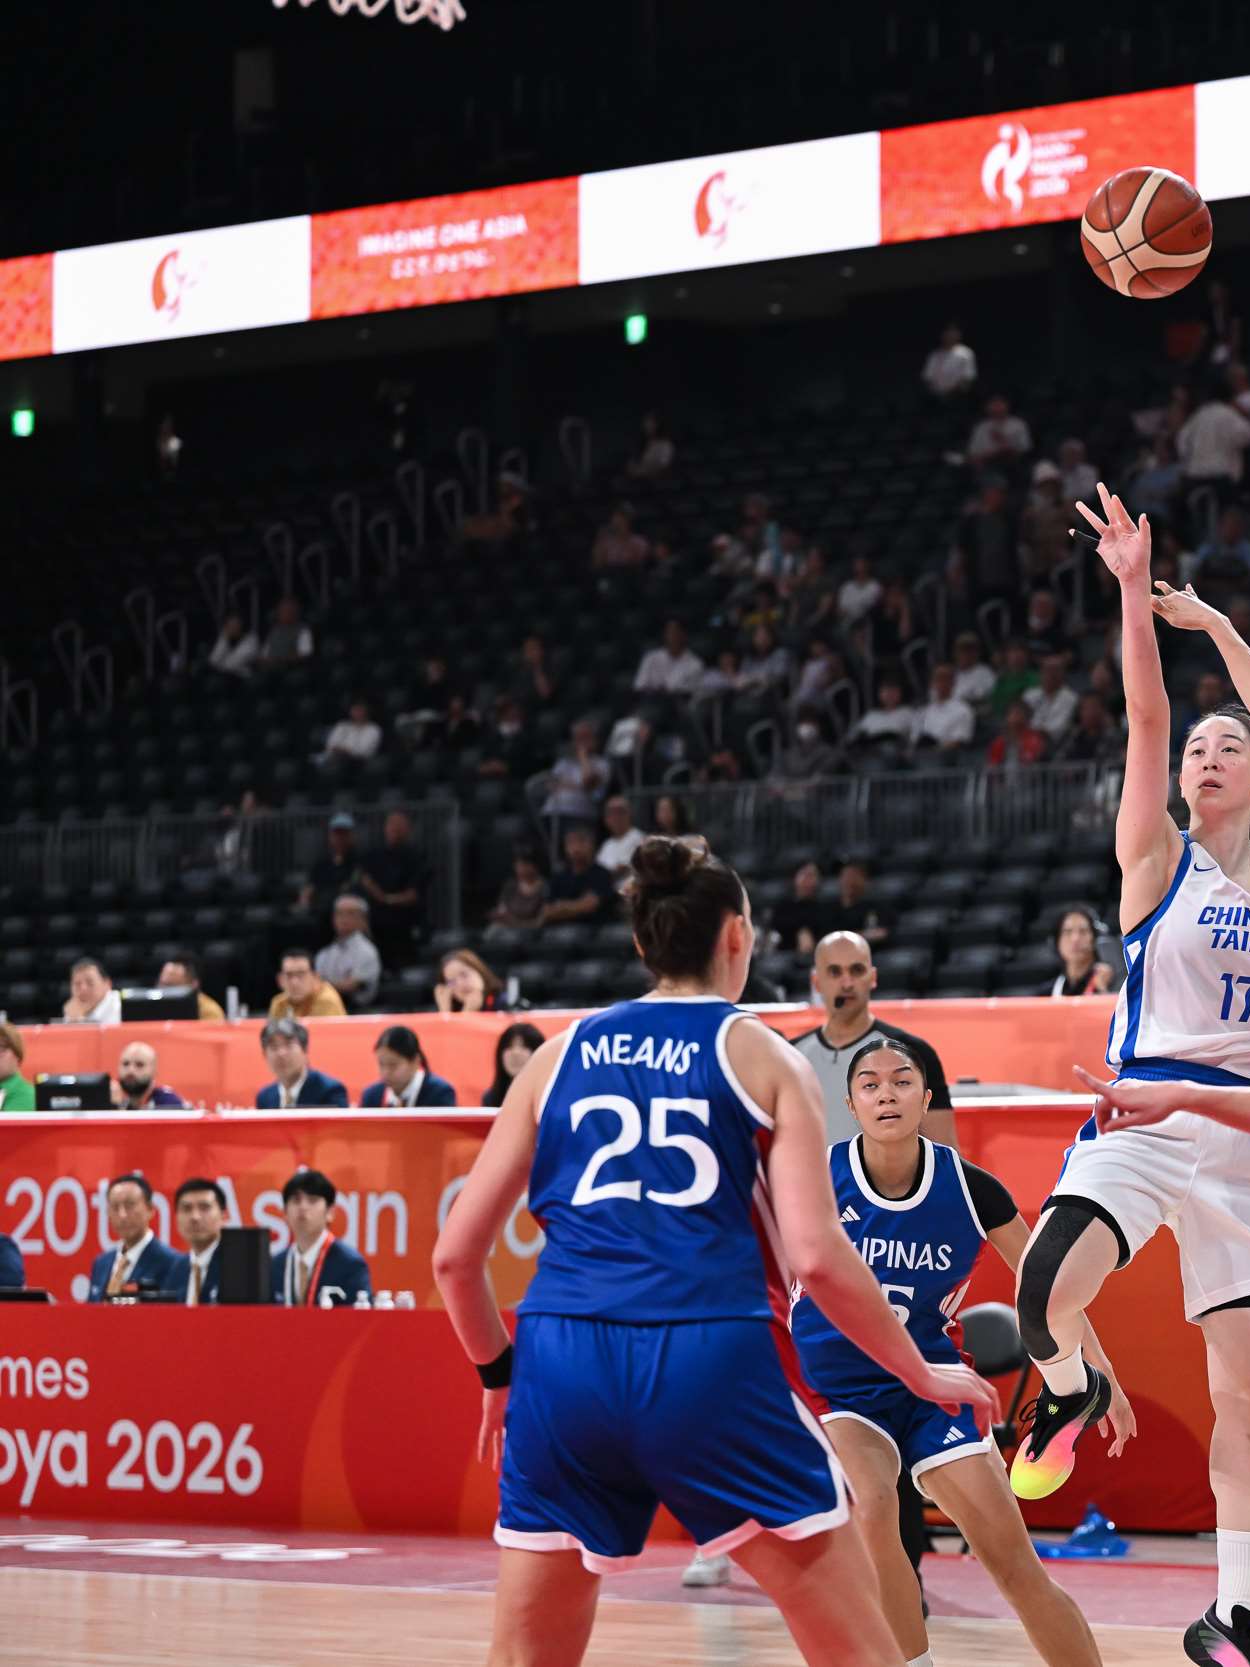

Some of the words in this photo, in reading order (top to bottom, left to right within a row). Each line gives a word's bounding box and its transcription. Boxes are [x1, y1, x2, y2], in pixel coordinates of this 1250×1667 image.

[581, 1034, 700, 1075] MEANS
[569, 1094, 720, 1207] 25
[106, 1419, 263, 1496] 2026
